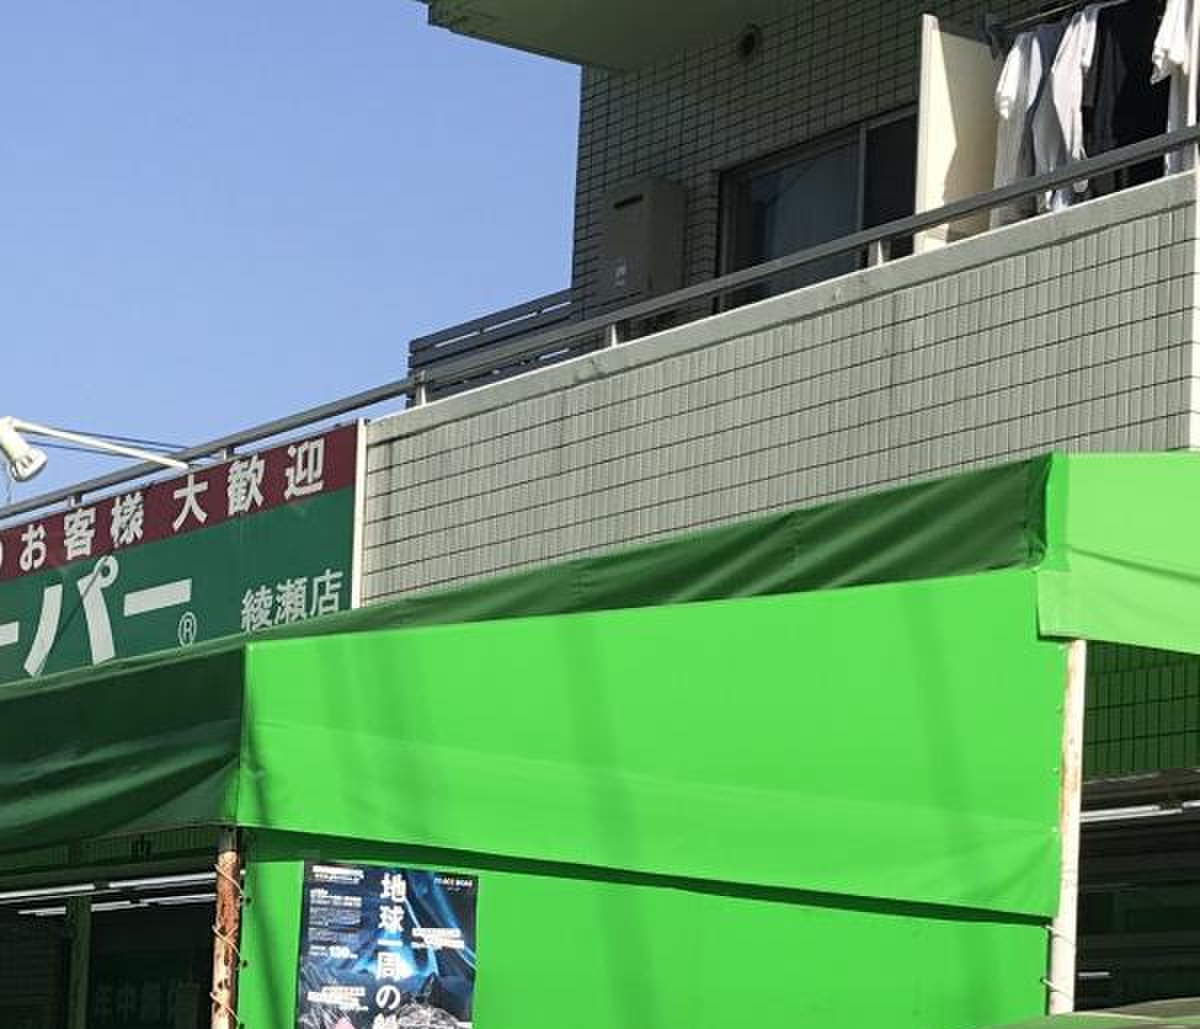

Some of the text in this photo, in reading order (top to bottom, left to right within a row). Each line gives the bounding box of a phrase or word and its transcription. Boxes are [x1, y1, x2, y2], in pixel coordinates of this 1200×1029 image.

[173, 438, 325, 532] 大歓迎
[241, 568, 343, 633] 綾瀬店
